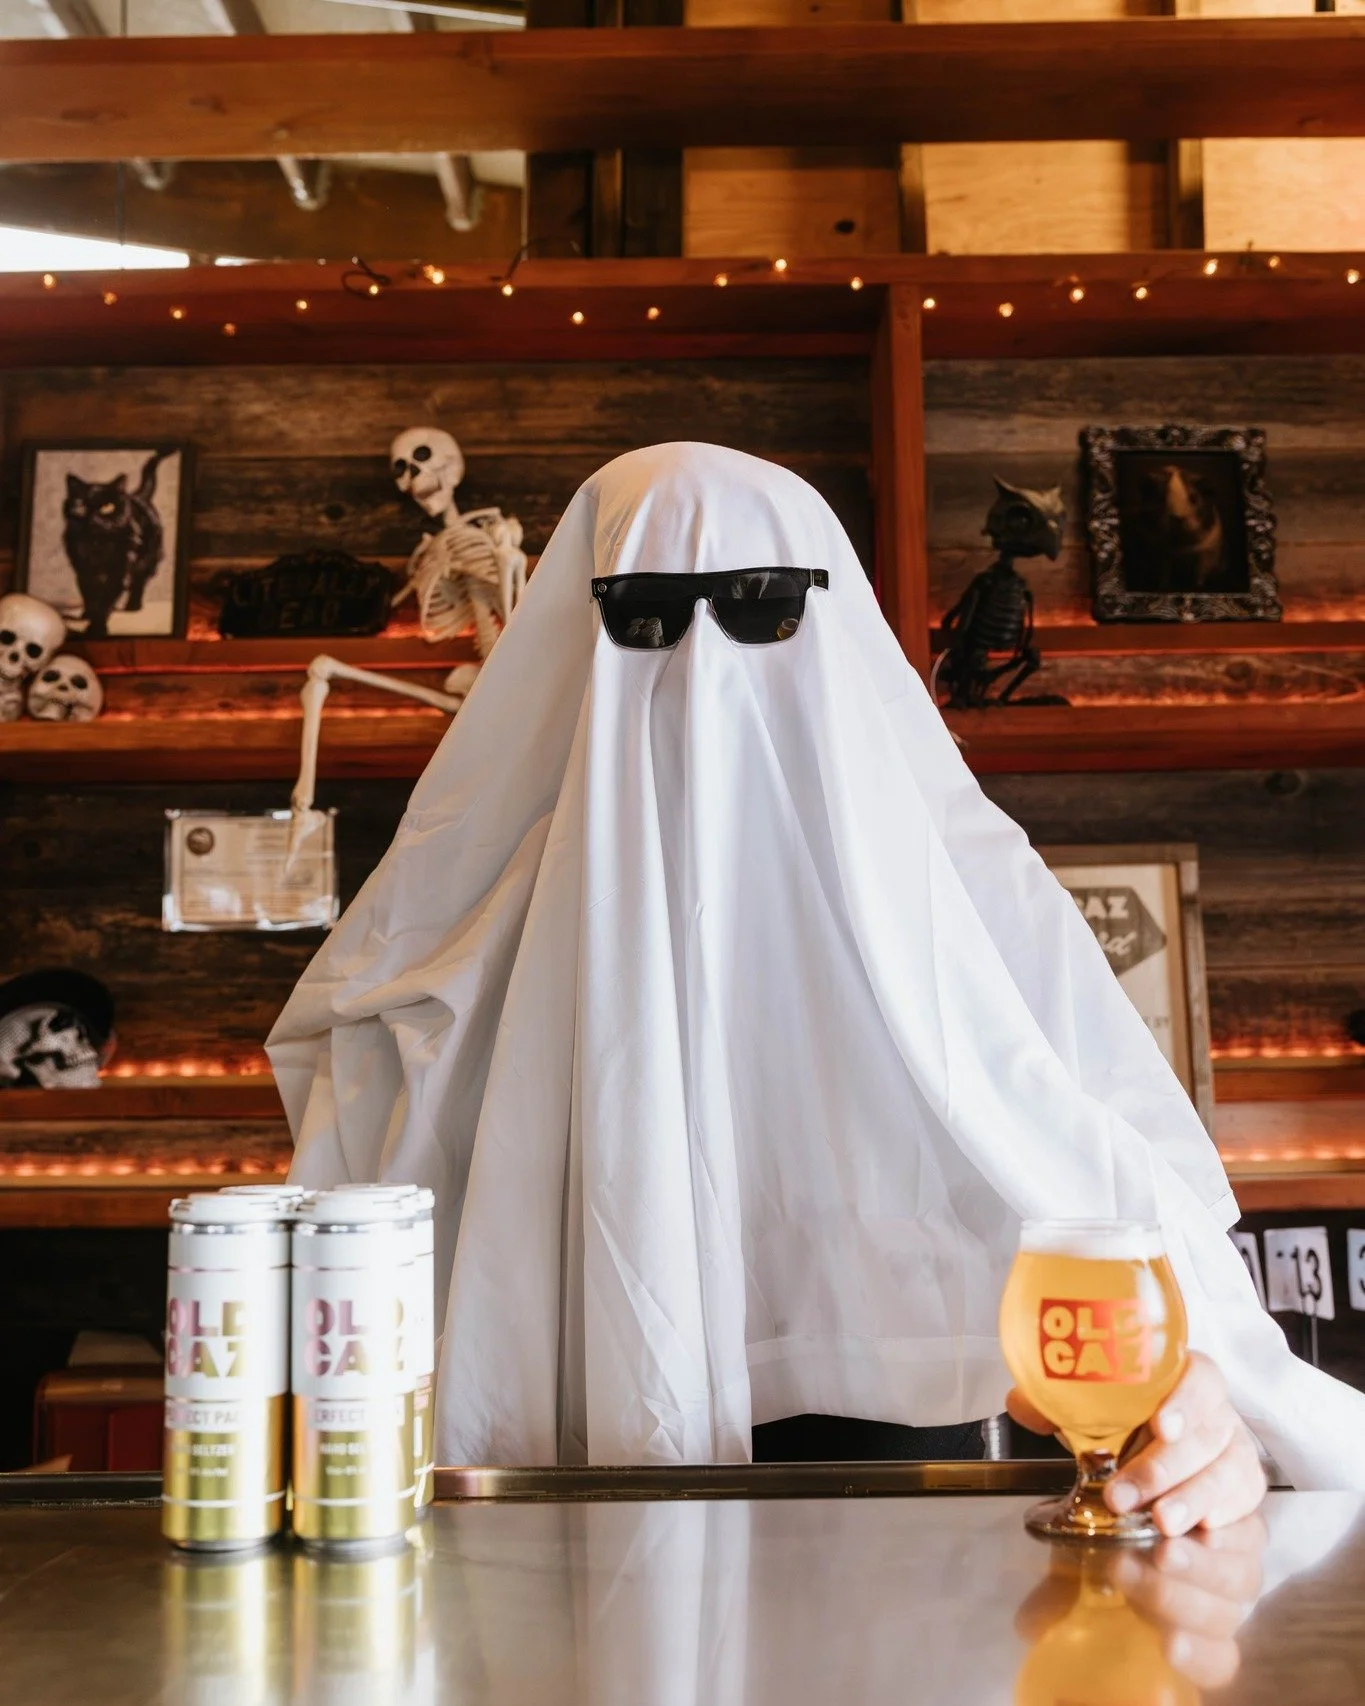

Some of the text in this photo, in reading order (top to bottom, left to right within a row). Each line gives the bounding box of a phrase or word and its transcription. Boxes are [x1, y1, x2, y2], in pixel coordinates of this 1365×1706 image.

[304, 1297, 404, 1338] OL
[1042, 1305, 1145, 1340] OLD
[304, 1337, 404, 1378] CA
[1043, 1340, 1145, 1377] CAZ
[311, 1409, 366, 1424] ERFECT
